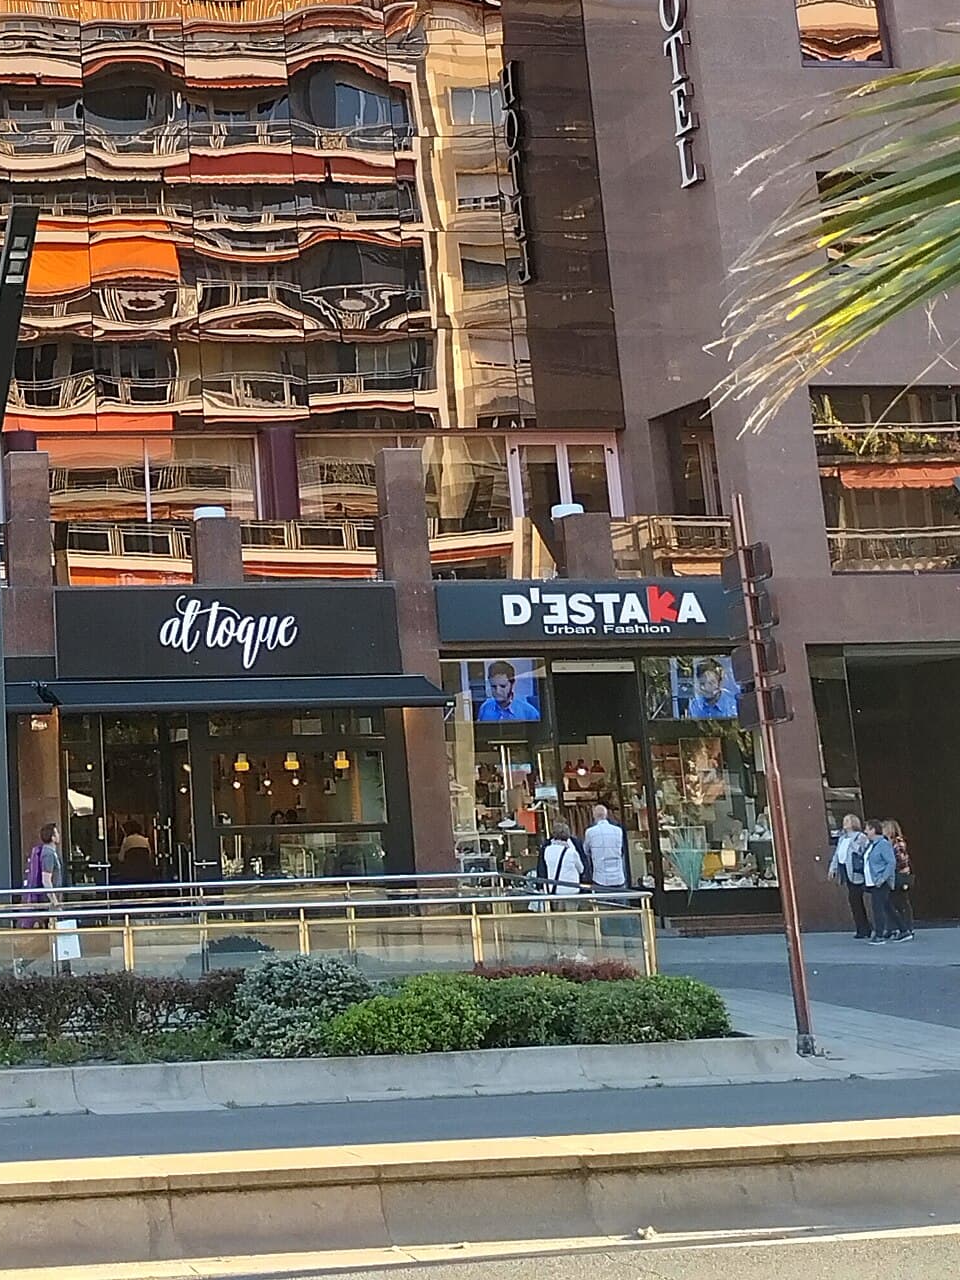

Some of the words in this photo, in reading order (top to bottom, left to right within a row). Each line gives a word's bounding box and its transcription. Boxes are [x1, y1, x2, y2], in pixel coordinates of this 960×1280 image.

[205, 601, 298, 669] toque
[543, 624, 596, 635] Urban
[603, 624, 671, 634] Fashion
